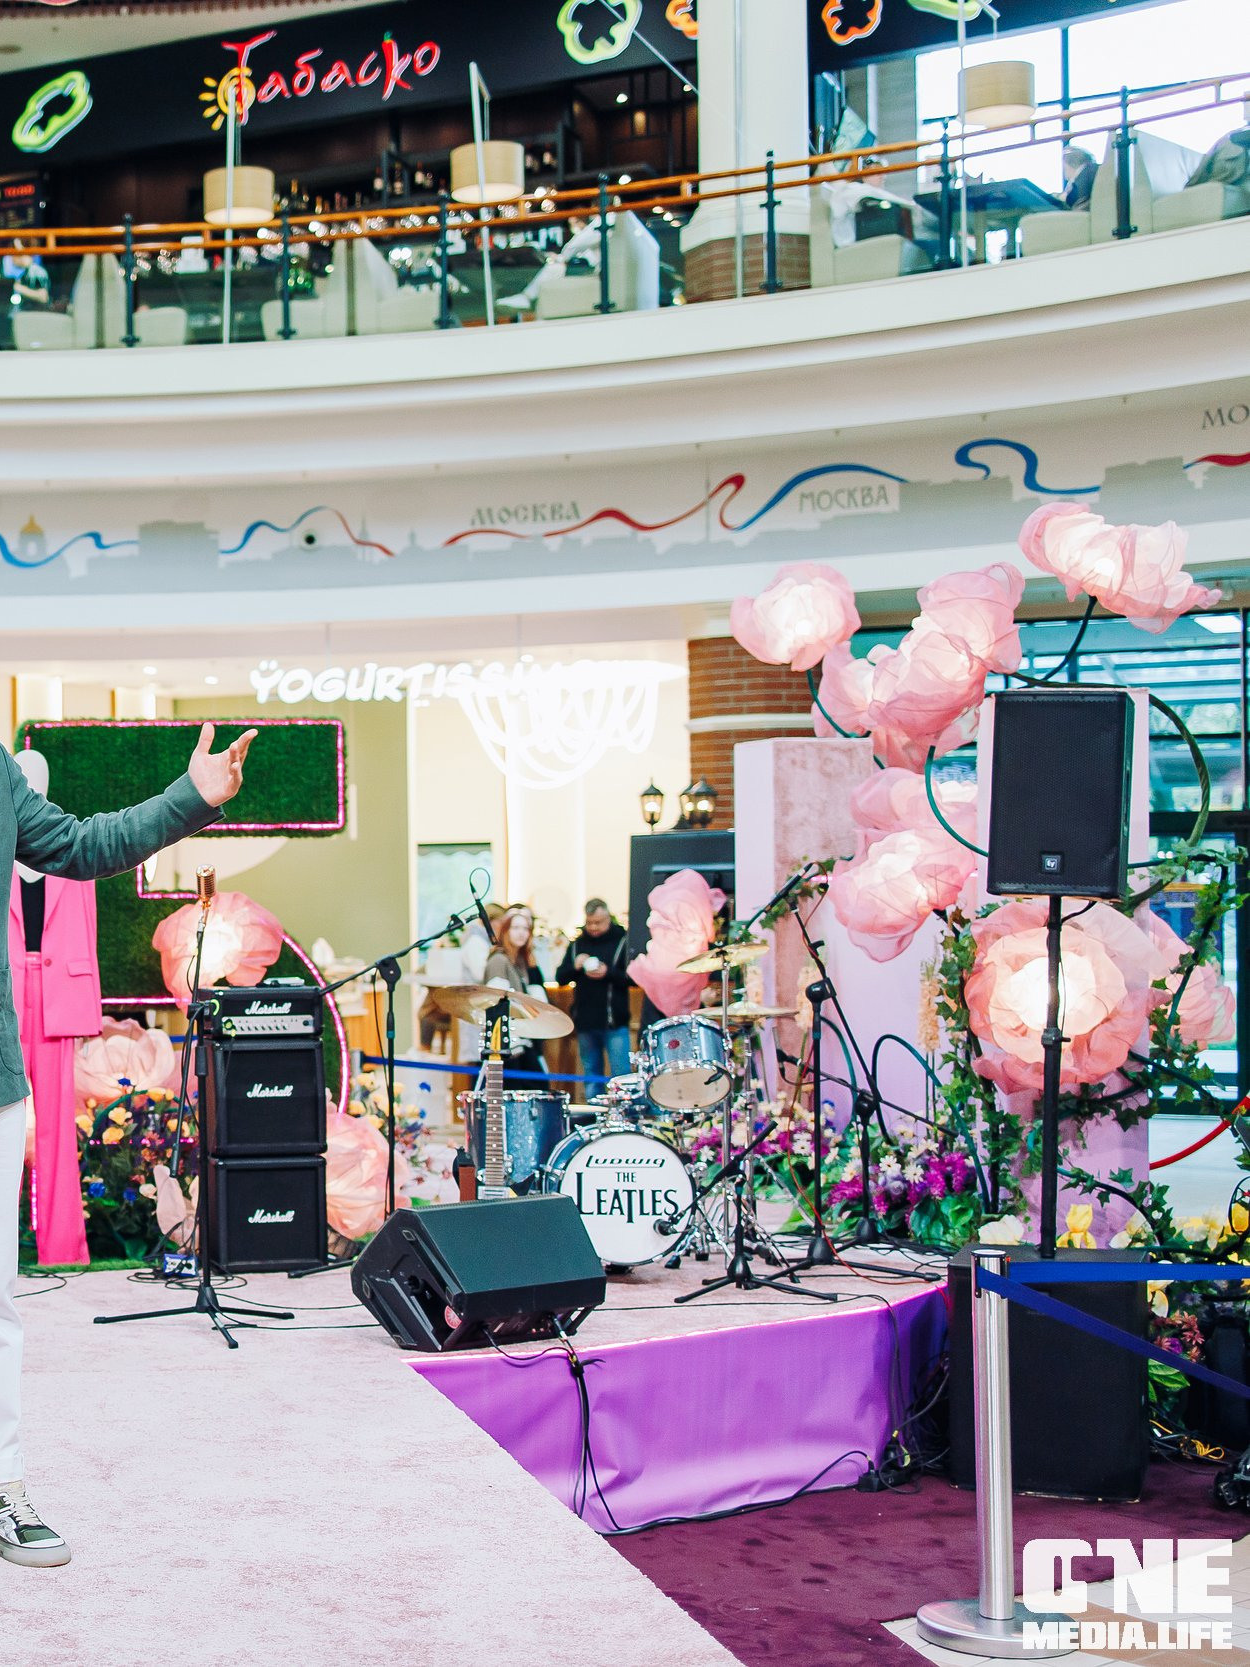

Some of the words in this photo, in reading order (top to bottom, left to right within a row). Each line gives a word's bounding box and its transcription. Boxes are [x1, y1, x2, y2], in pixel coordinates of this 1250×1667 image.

[799, 484, 889, 512] МОСКВА
[470, 500, 580, 526] МОСКВА
[245, 1001, 292, 1015] Marshall
[247, 1083, 294, 1098] Marshall
[616, 1172, 637, 1182] THE
[248, 1209, 295, 1223] Marshall
